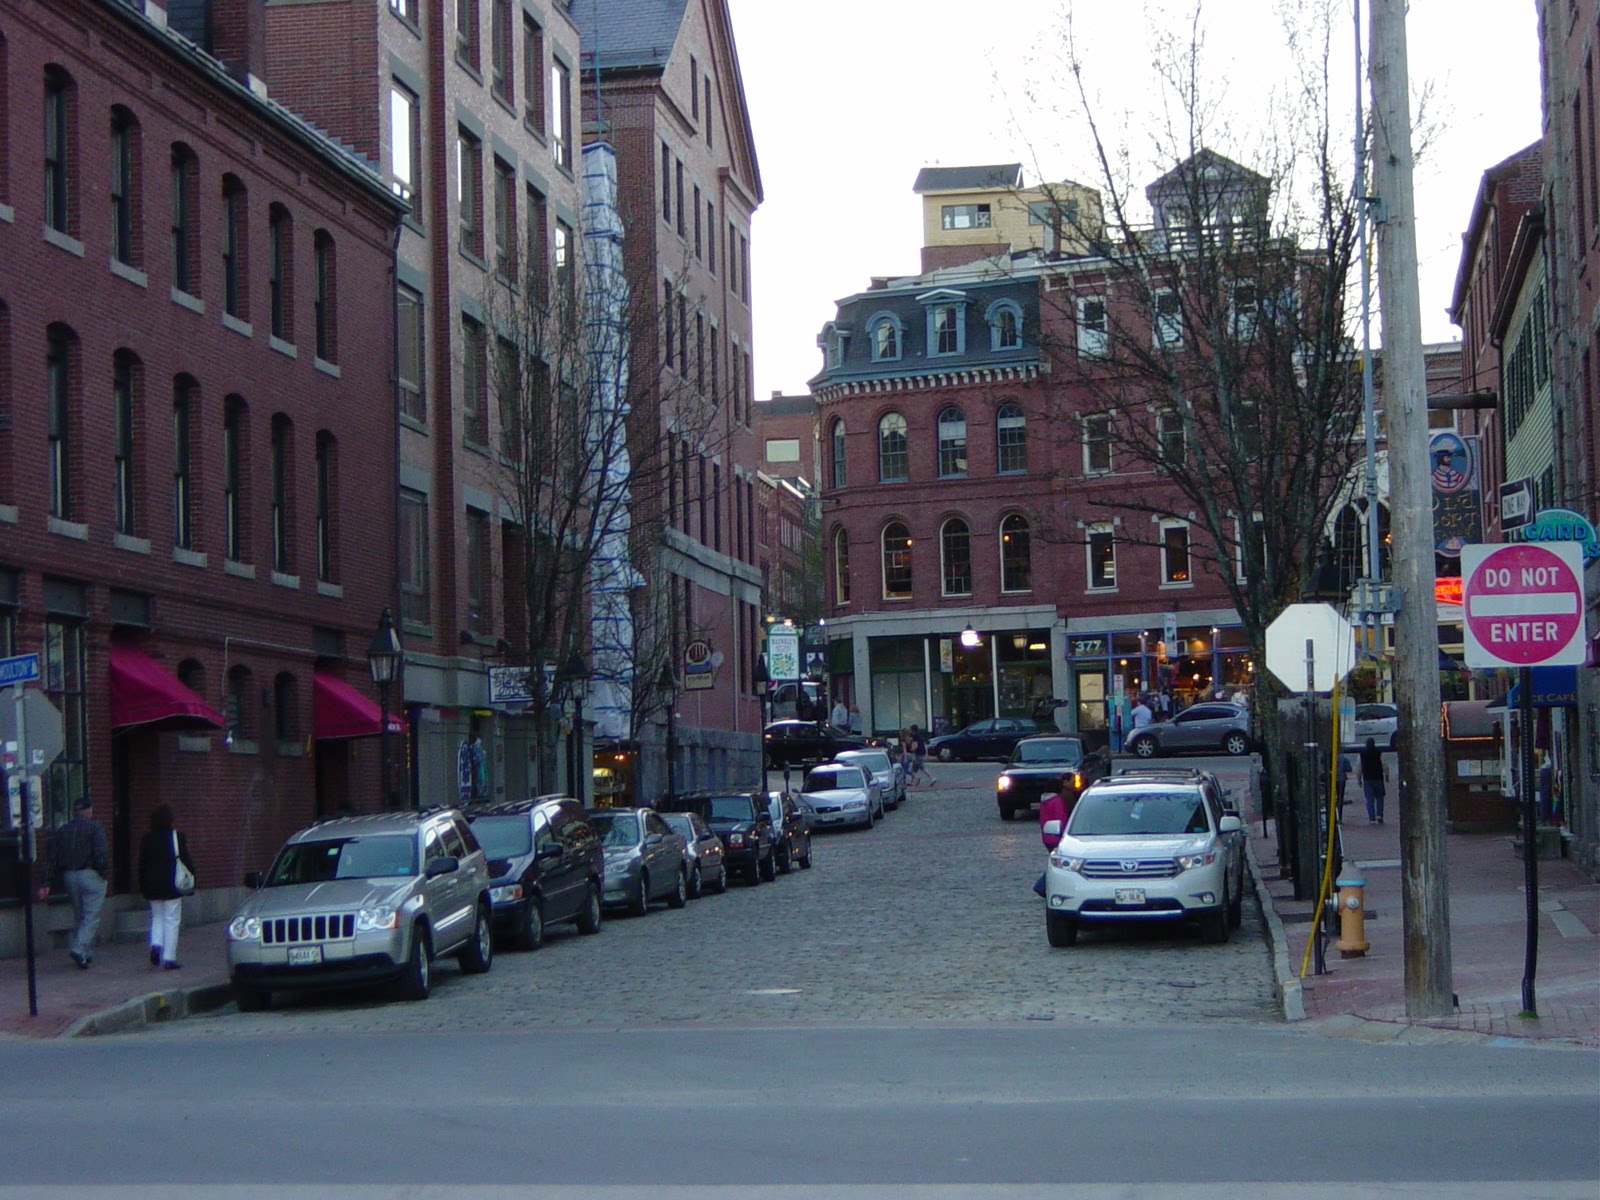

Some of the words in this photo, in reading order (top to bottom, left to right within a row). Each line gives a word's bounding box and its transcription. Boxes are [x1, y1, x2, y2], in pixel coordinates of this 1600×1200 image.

[1503, 496, 1515, 515] ONE
[1433, 511, 1479, 528] ORT
[1524, 523, 1589, 541] CARD
[1485, 568, 1511, 588] DO
[1521, 567, 1560, 587] NOT
[1490, 621, 1558, 643] ENTER
[1075, 639, 1102, 652] 377
[1514, 693, 1545, 703] JCE
